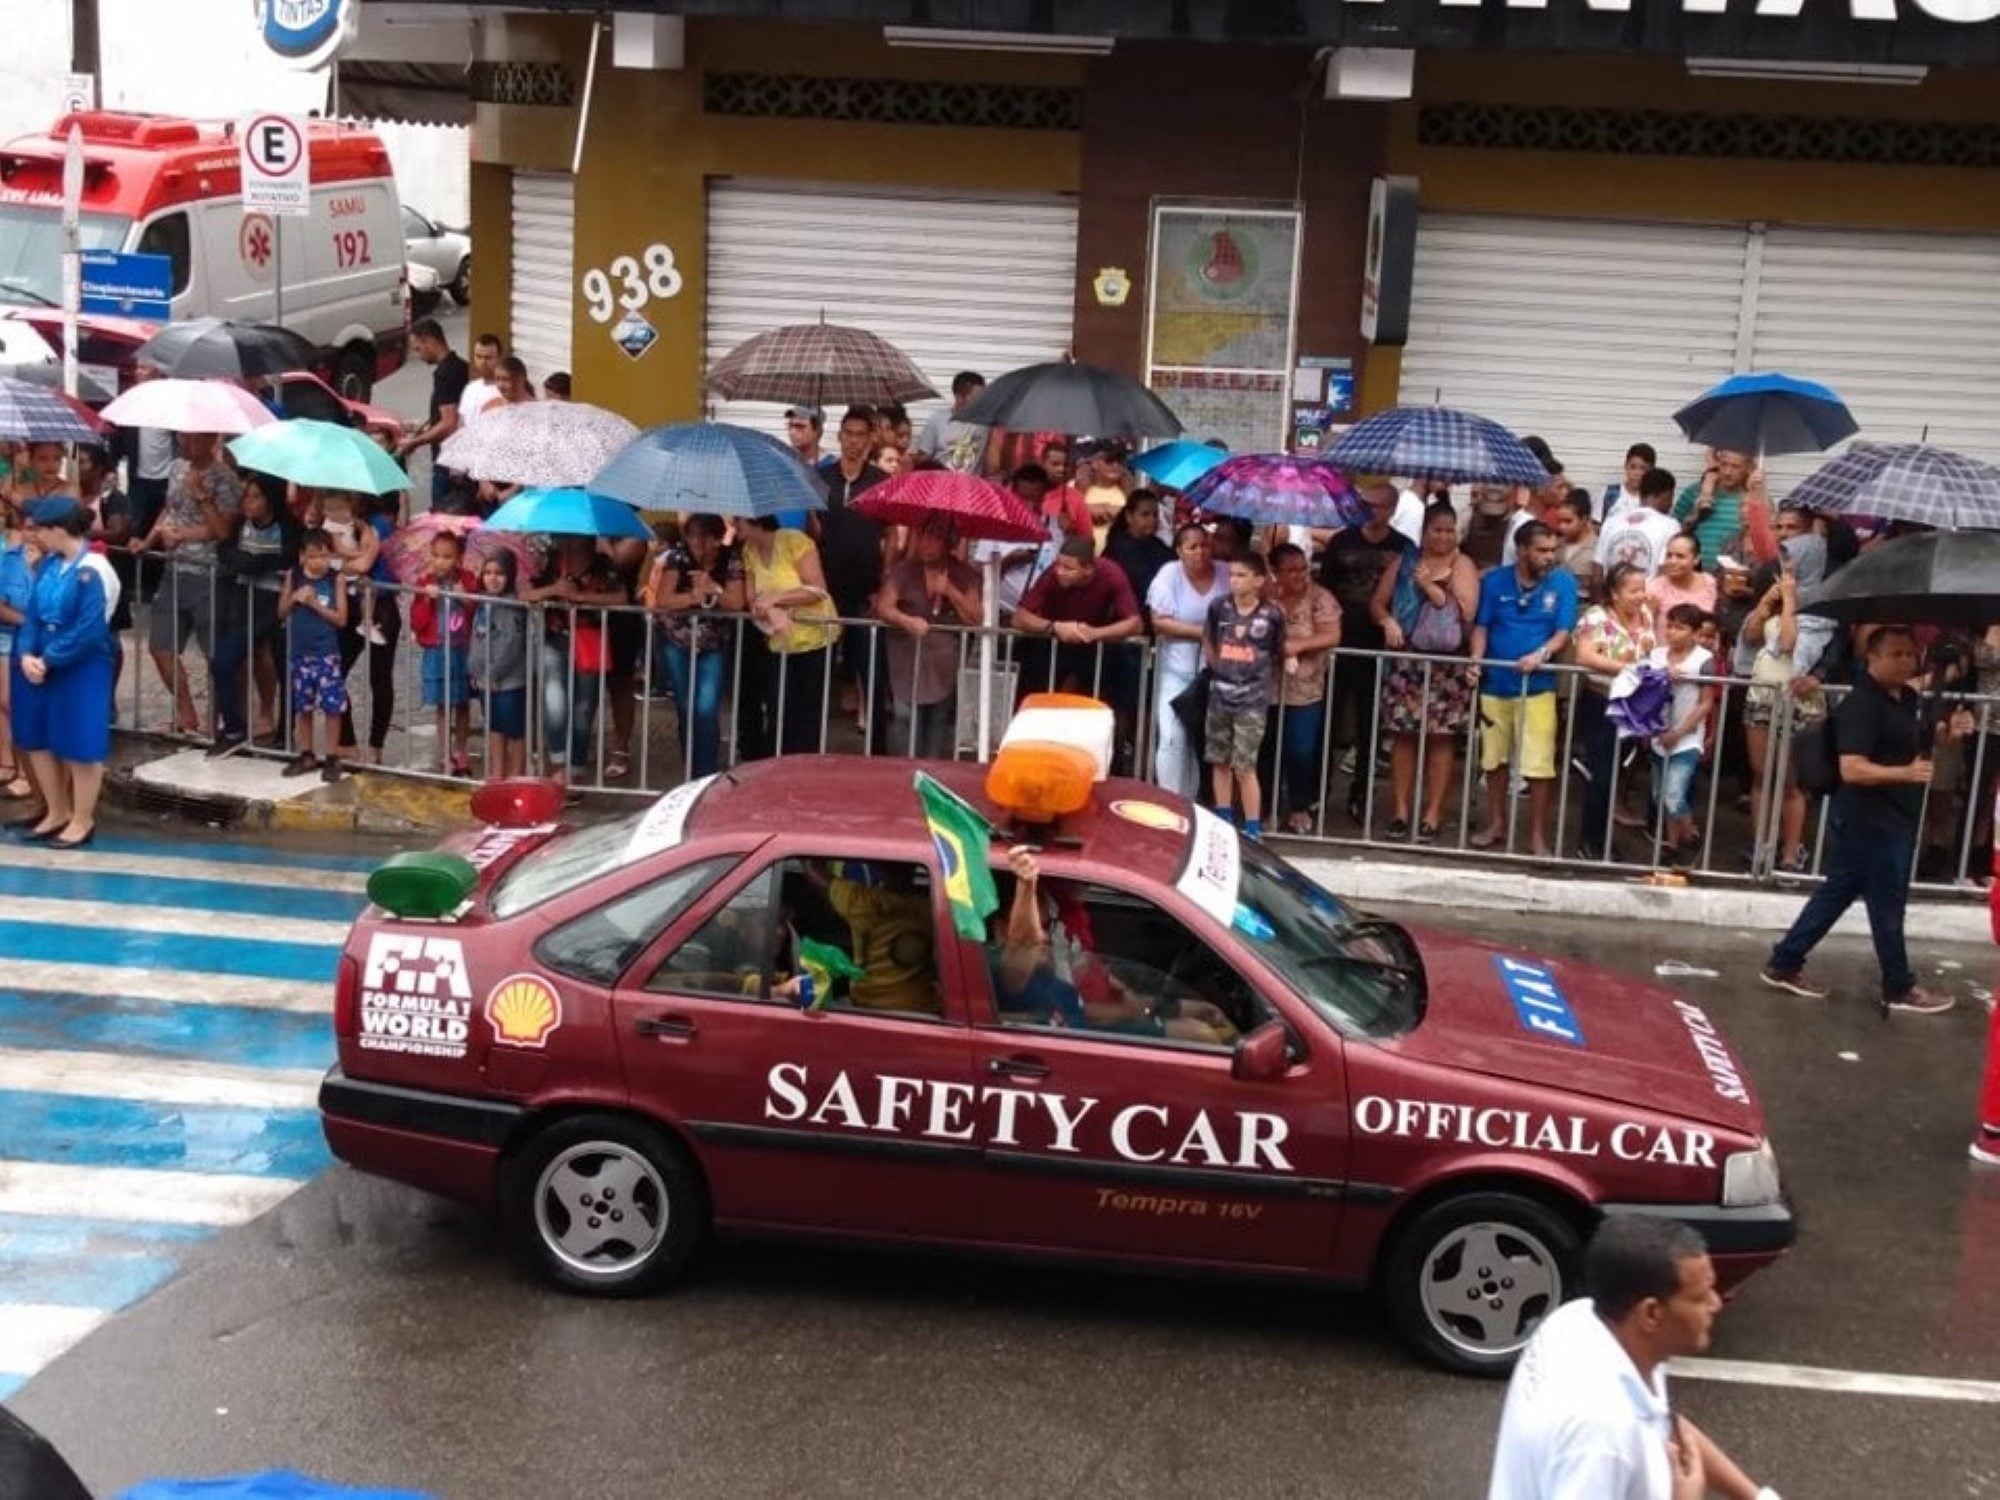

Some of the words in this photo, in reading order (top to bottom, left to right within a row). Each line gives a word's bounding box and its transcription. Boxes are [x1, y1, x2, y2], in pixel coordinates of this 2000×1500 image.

[263, 126, 286, 164] E
[332, 229, 372, 268] 192
[583, 243, 683, 323] 938
[362, 991, 458, 1015] FORMULA
[1502, 957, 1576, 1040] FIAT
[361, 1010, 468, 1041] WORLD
[764, 1062, 1100, 1152] SAFETY
[1110, 1104, 1296, 1171] CAR
[1354, 1095, 1601, 1156] OFFICIAL
[1609, 1121, 1719, 1169] CAR
[1096, 1188, 1208, 1216] Tempra
[1218, 1202, 1264, 1219] 16V
